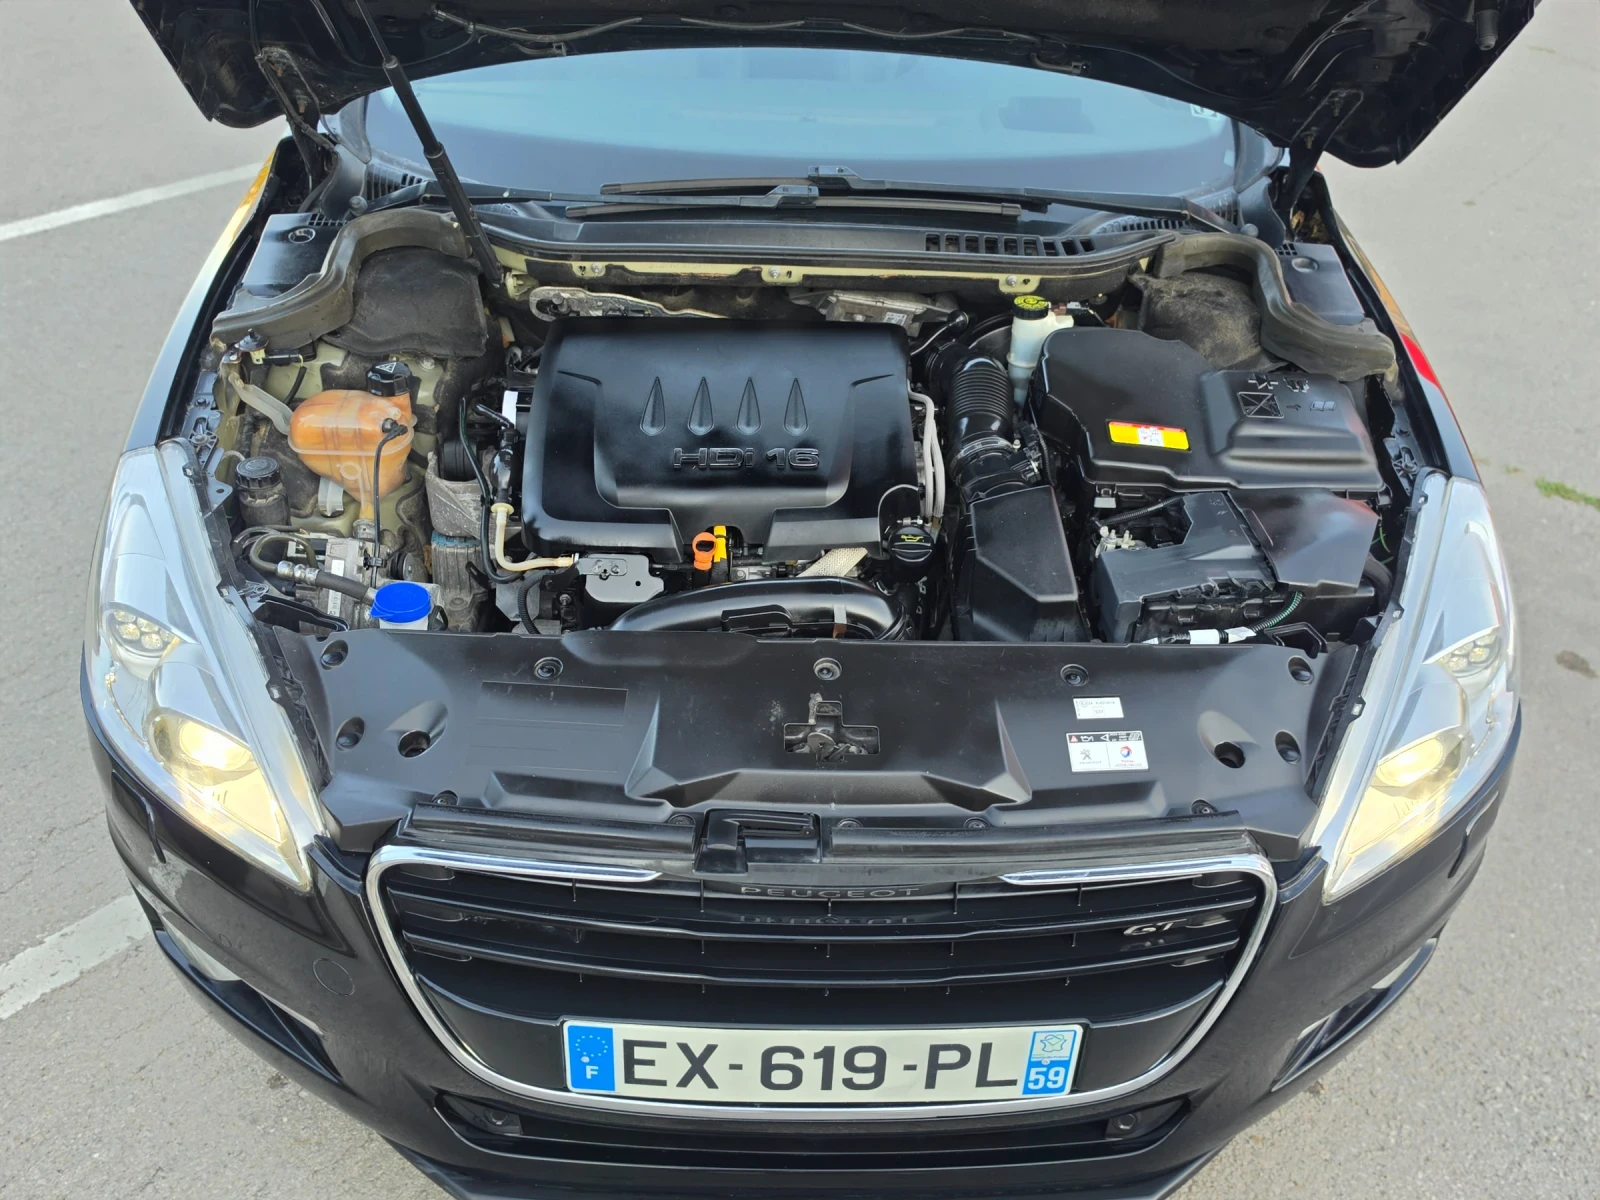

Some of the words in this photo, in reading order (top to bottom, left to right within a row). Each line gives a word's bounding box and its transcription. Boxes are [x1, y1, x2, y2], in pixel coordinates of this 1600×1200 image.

[766, 448, 819, 469] 16
[740, 886, 920, 898] PEUGEOT
[1123, 919, 1187, 936] GT
[586, 1065, 599, 1079] F
[1027, 1066, 1066, 1090] 59
